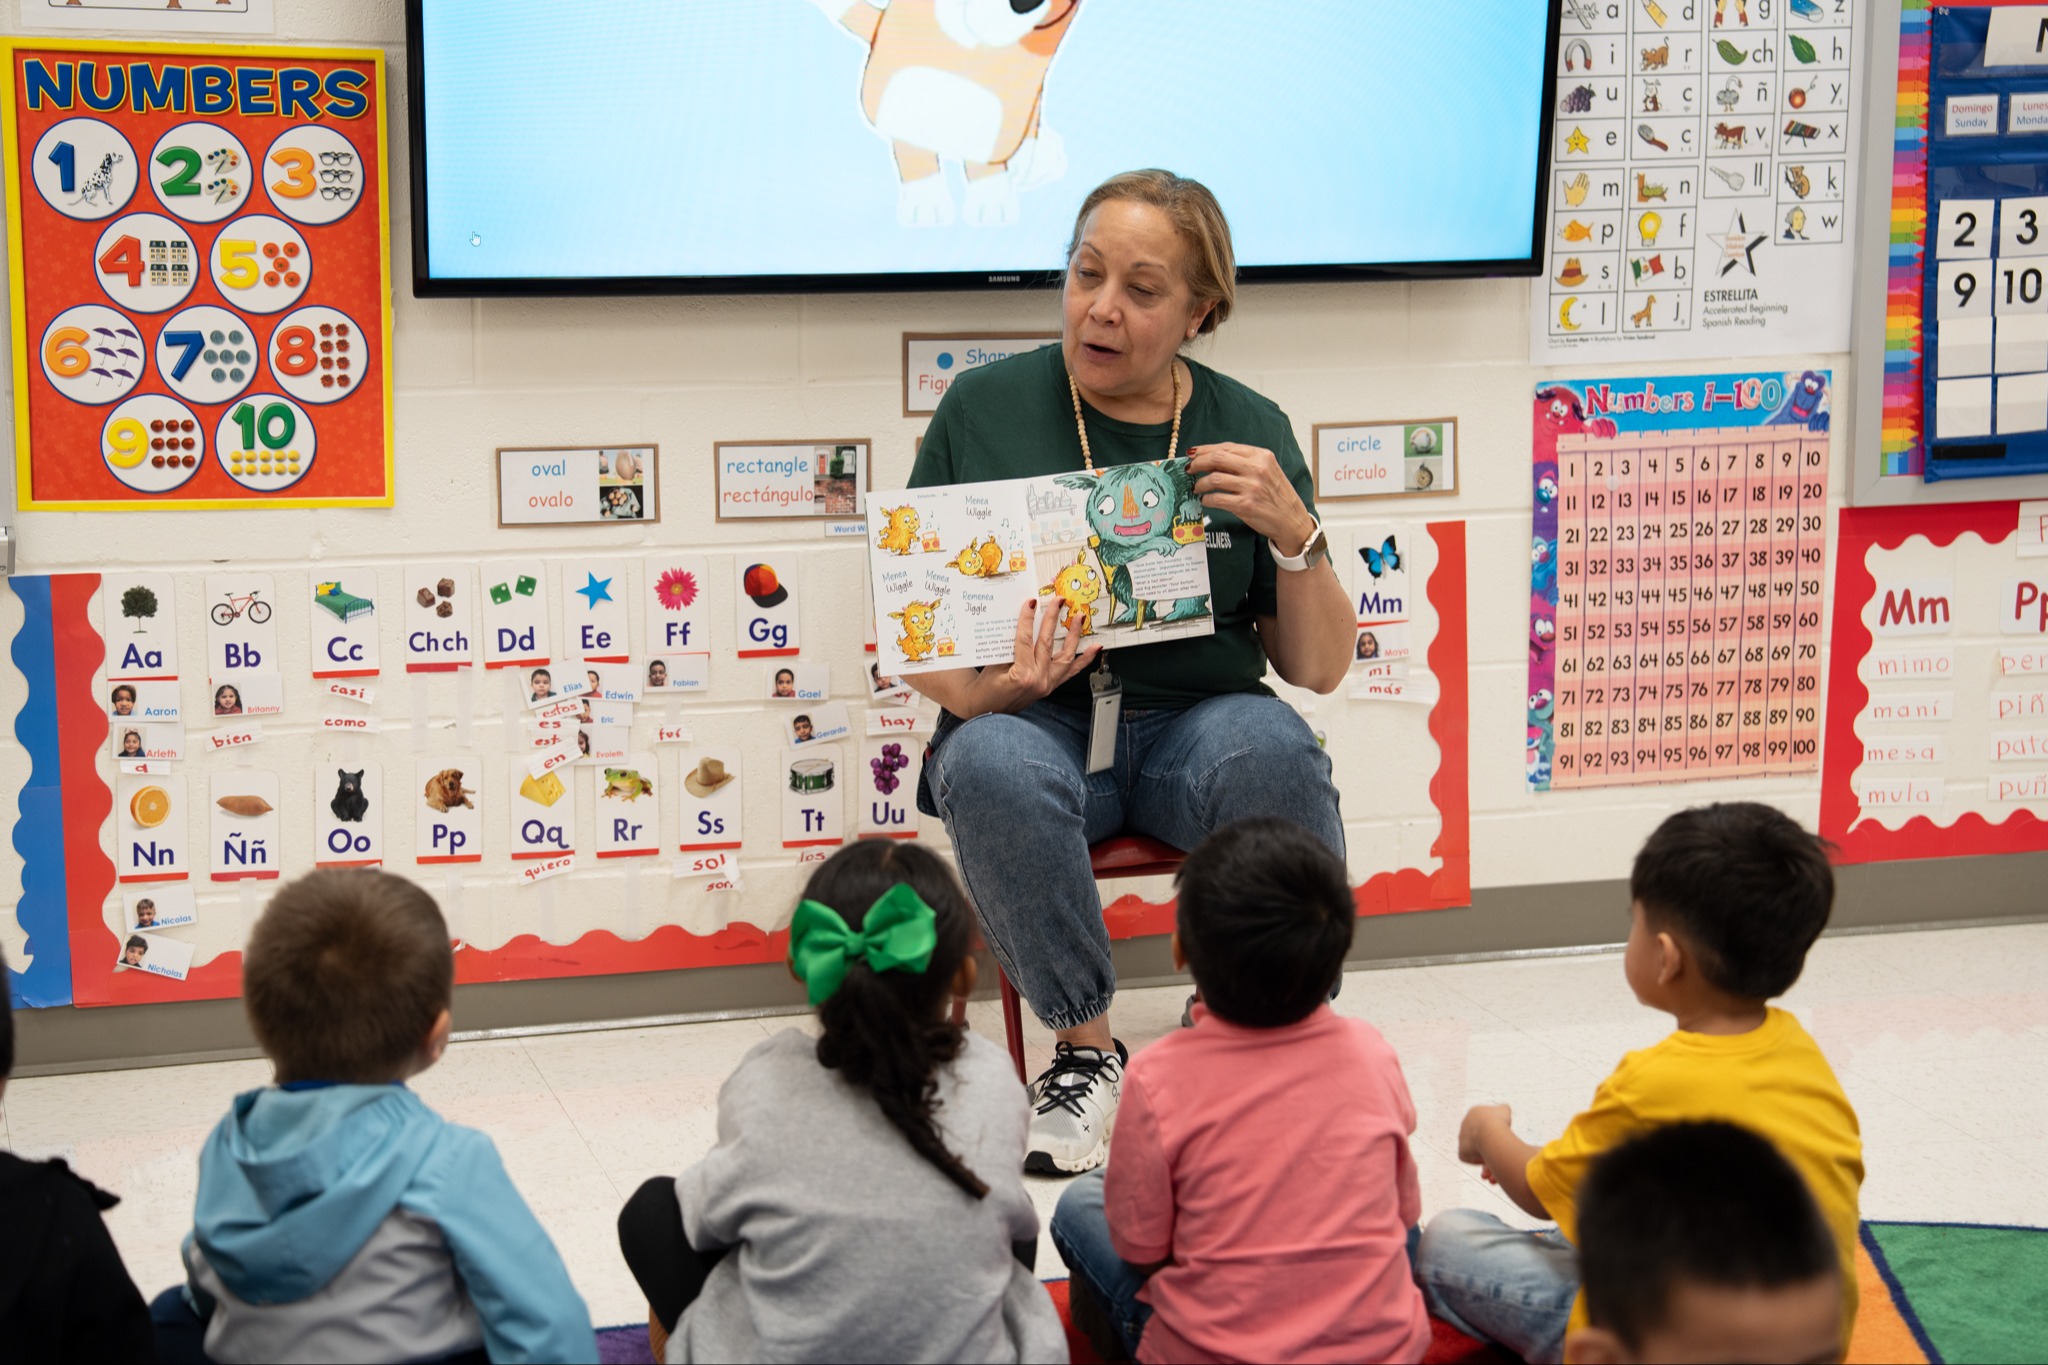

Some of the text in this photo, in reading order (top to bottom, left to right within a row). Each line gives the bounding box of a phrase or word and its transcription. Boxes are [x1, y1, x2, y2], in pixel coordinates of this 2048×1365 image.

[1606, 5, 1619, 19] a
[1683, 0, 1694, 20] d
[1759, 0, 1770, 19] g
[1609, 44, 1616, 64] i
[1684, 47, 1693, 63] r
[1752, 38, 1774, 63] ch
[1832, 36, 1843, 60] h
[22, 58, 369, 120] NUMBERS
[1606, 86, 1618, 102] u
[1683, 86, 1692, 102] c
[1757, 82, 1767, 101] ñ
[1830, 83, 1842, 104] y
[1952, 103, 1993, 115] Domingo
[1828, 125, 1839, 138] x
[1955, 118, 1988, 128] Sunday
[1606, 131, 1617, 146] e
[1682, 128, 1691, 144] c
[1756, 127, 1766, 140] v
[48, 141, 75, 192] 1
[155, 146, 201, 196] 2
[271, 147, 317, 199] 3
[1680, 179, 1690, 194] n
[1828, 167, 1837, 190] k
[1603, 182, 1619, 197] m
[1679, 213, 1688, 237] f
[1822, 215, 1838, 229] w
[1954, 208, 2039, 247] 2 3
[1602, 222, 1614, 244] p
[98, 234, 144, 287] 4
[219, 239, 259, 289] 5
[1675, 256, 1686, 280] b
[988, 275, 1020, 283] SAMSUNG
[1601, 264, 1609, 280] s
[1703, 289, 1758, 302] ESTRELLITA
[1954, 269, 2042, 308] 9 10
[1672, 293, 1681, 321] j
[1703, 302, 1788, 316] Accelerated Beginning
[1702, 315, 1766, 328] Spanish Reading
[45, 327, 90, 377] 6
[163, 331, 205, 382] 7
[275, 325, 318, 376] 8
[1585, 378, 1781, 416] Numbers 1-100
[232, 402, 295, 450] 10
[107, 417, 148, 468] 9
[1337, 435, 1381, 453] circle
[531, 458, 566, 477] oval
[726, 455, 809, 477] rectangle
[1334, 462, 1387, 482] círculo
[1569, 451, 1821, 477] 1 2 3 4 5 6 7 8 9 10
[528, 489, 574, 509] ovalo
[723, 485, 814, 509] rectángulo
[965, 495, 989, 505] Menea
[966, 507, 992, 520] Wiggle
[882, 570, 908, 583] Menea
[925, 569, 950, 583] Menea
[885, 579, 914, 593] Wiggle
[924, 581, 951, 596] Wiggle
[962, 591, 994, 601] Remenea
[1359, 592, 1402, 615] Mm
[964, 602, 987, 616] Jiggle
[1879, 588, 1950, 627] Mm
[498, 626, 535, 652] Dd
[581, 625, 611, 649] Ee
[666, 622, 691, 646] Ff
[749, 617, 787, 648] Gg
[121, 643, 163, 669] Aa
[225, 643, 261, 669] Bb
[327, 636, 364, 662] Cc
[1384, 648, 1409, 658] Maya
[1878, 653, 1950, 676] mimo
[330, 684, 365, 699] casi
[563, 682, 583, 694] Elias
[673, 679, 699, 687] Fabian
[1369, 682, 1403, 695] más
[605, 691, 634, 700] Edwin
[798, 689, 821, 699] Gael
[144, 707, 177, 717] Aaron
[247, 705, 280, 714] Britanny
[542, 702, 578, 718] estos
[1873, 700, 1940, 719] maní
[324, 718, 367, 728] como
[539, 720, 562, 729] es
[601, 716, 614, 724] Eric
[880, 715, 915, 731] hay
[211, 733, 252, 749] bien
[816, 725, 848, 740] Gerardo
[146, 748, 177, 759] Arleth
[543, 753, 566, 769] en
[1560, 739, 1816, 769] 91 92 93 94 95 96 97 98 99 100
[1867, 742, 1934, 762] mesa
[1868, 781, 1930, 804] mula
[697, 810, 725, 835] Ss
[801, 809, 825, 832] Tt
[871, 802, 906, 826] Uu
[520, 818, 570, 850] Qq
[613, 817, 643, 842] Rr
[224, 831, 267, 865] Ññ
[328, 828, 371, 854] Oo
[432, 823, 467, 856] Pp
[132, 841, 175, 867] Nn
[800, 852, 826, 863] los
[524, 858, 571, 880] quiero
[161, 915, 192, 926] Nicolas
[147, 963, 183, 978] Nicholas
